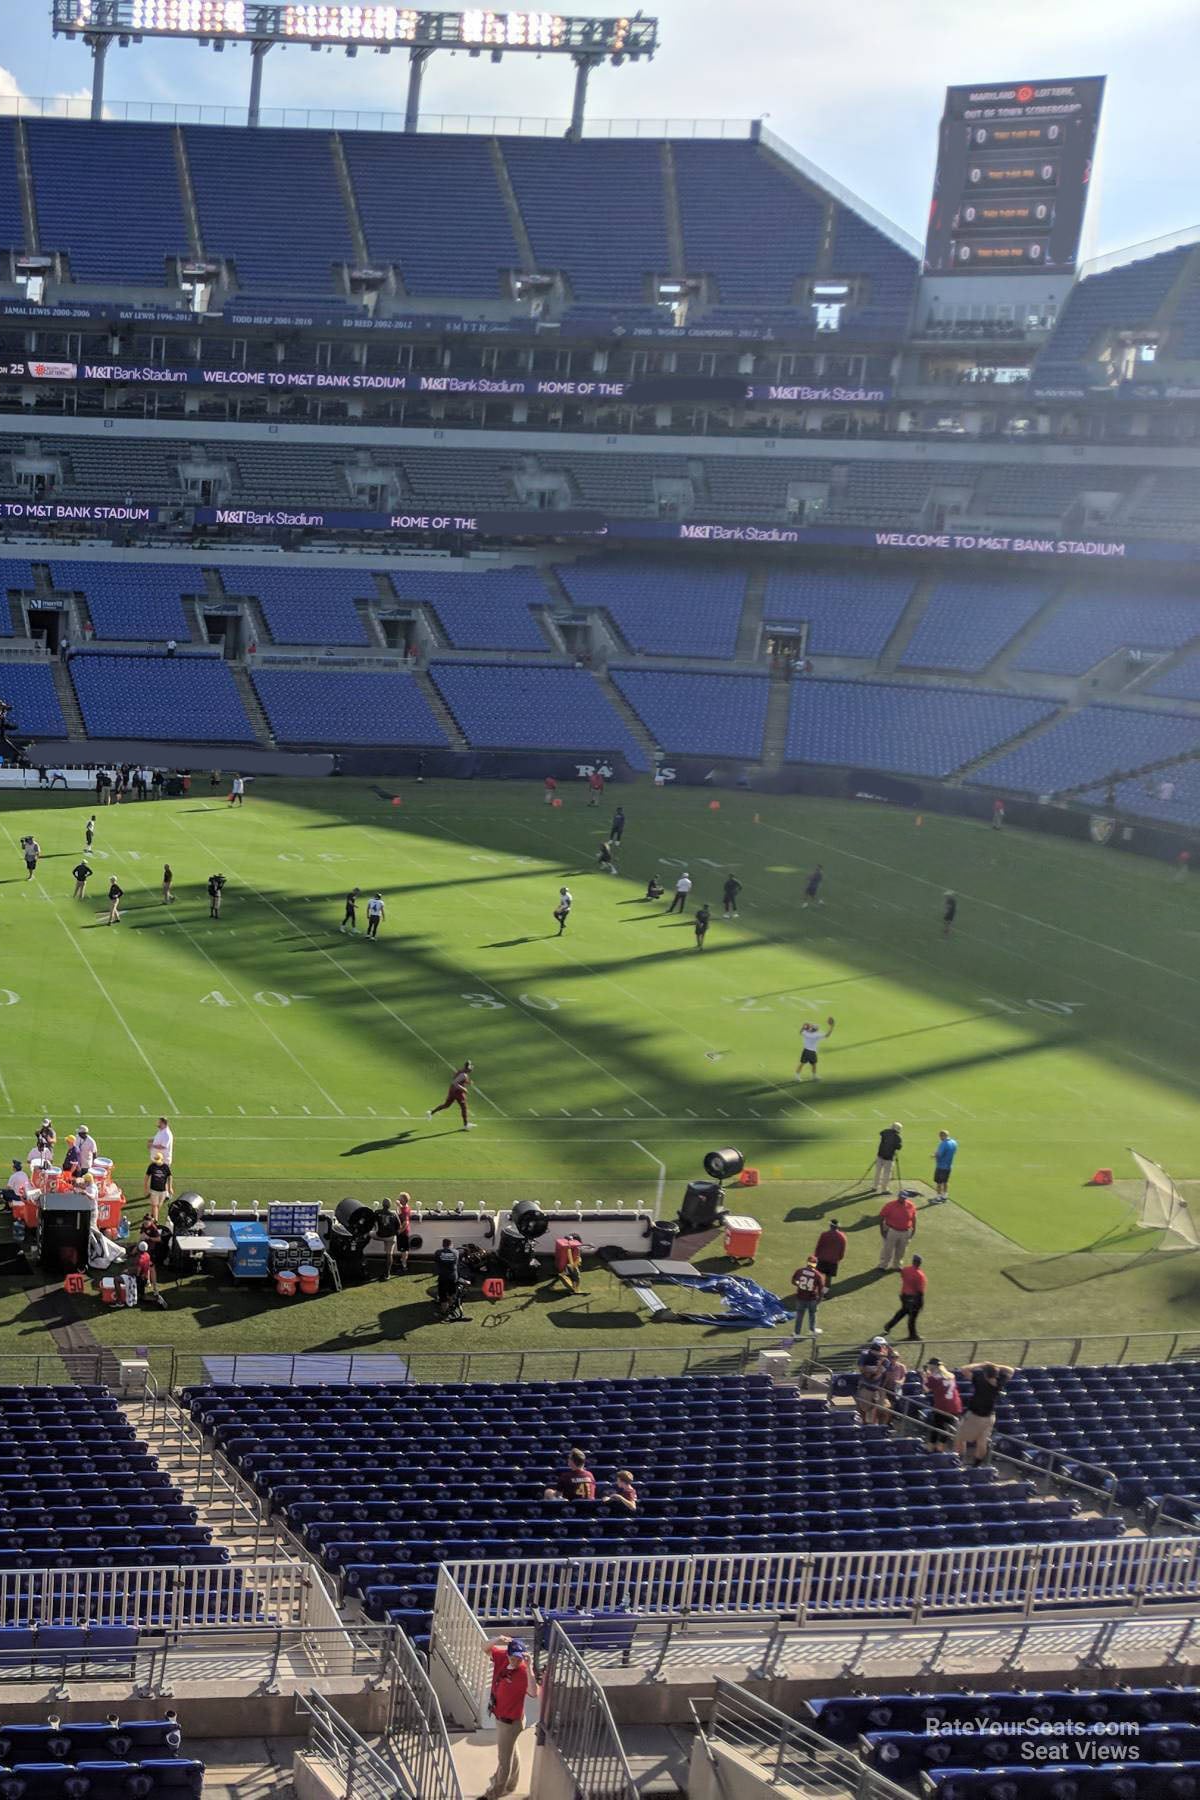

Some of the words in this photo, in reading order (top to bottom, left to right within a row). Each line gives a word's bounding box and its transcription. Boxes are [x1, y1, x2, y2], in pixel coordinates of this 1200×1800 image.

[4, 307, 28, 315] JAMAL
[29, 307, 50, 316] LEWIS
[52, 308, 90, 317] 2000-2006
[135, 312, 155, 320] LEWIS
[232, 316, 252, 324] TODD
[10, 364, 24, 375] 25
[84, 366, 114, 379] M&T
[114, 367, 141, 380] Bank
[141, 368, 187, 382] Stadium
[204, 371, 264, 384] WELCOME
[268, 373, 285, 385] TO
[288, 374, 315, 386] M&T
[317, 375, 350, 387] BANK
[353, 376, 406, 389] STADIUM
[420, 377, 450, 391] M&T
[450, 379, 478, 392] Bank
[478, 380, 525, 393] Stadium
[538, 382, 575, 393] HOME
[578, 382, 596, 394] OF
[599, 383, 623, 395] THE
[768, 386, 801, 400] M&T
[801, 387, 832, 400] Bank
[832, 387, 884, 401] Stadium
[5, 504, 23, 516] TO
[26, 505, 54, 517] M&T
[56, 506, 91, 518] BANK
[94, 507, 149, 520] STADIUM
[216, 510, 246, 523] M&T
[246, 511, 275, 525] Bank
[276, 512, 323, 526] Stadium
[391, 516, 429, 528] HOME
[432, 517, 450, 529] OF
[454, 518, 478, 530] THE
[680, 525, 712, 538] M&T
[712, 526, 744, 540] Bank
[745, 527, 798, 542] Stadium
[876, 533, 950, 548] WELCOME
[953, 536, 976, 549] TO
[978, 538, 1010, 551] M&T
[1013, 539, 1055, 553] BANK
[1057, 541, 1125, 557] STADIUM
[69, 1277, 84, 1291] 50
[488, 1282, 503, 1296] 40
[799, 1275, 814, 1291] 24
